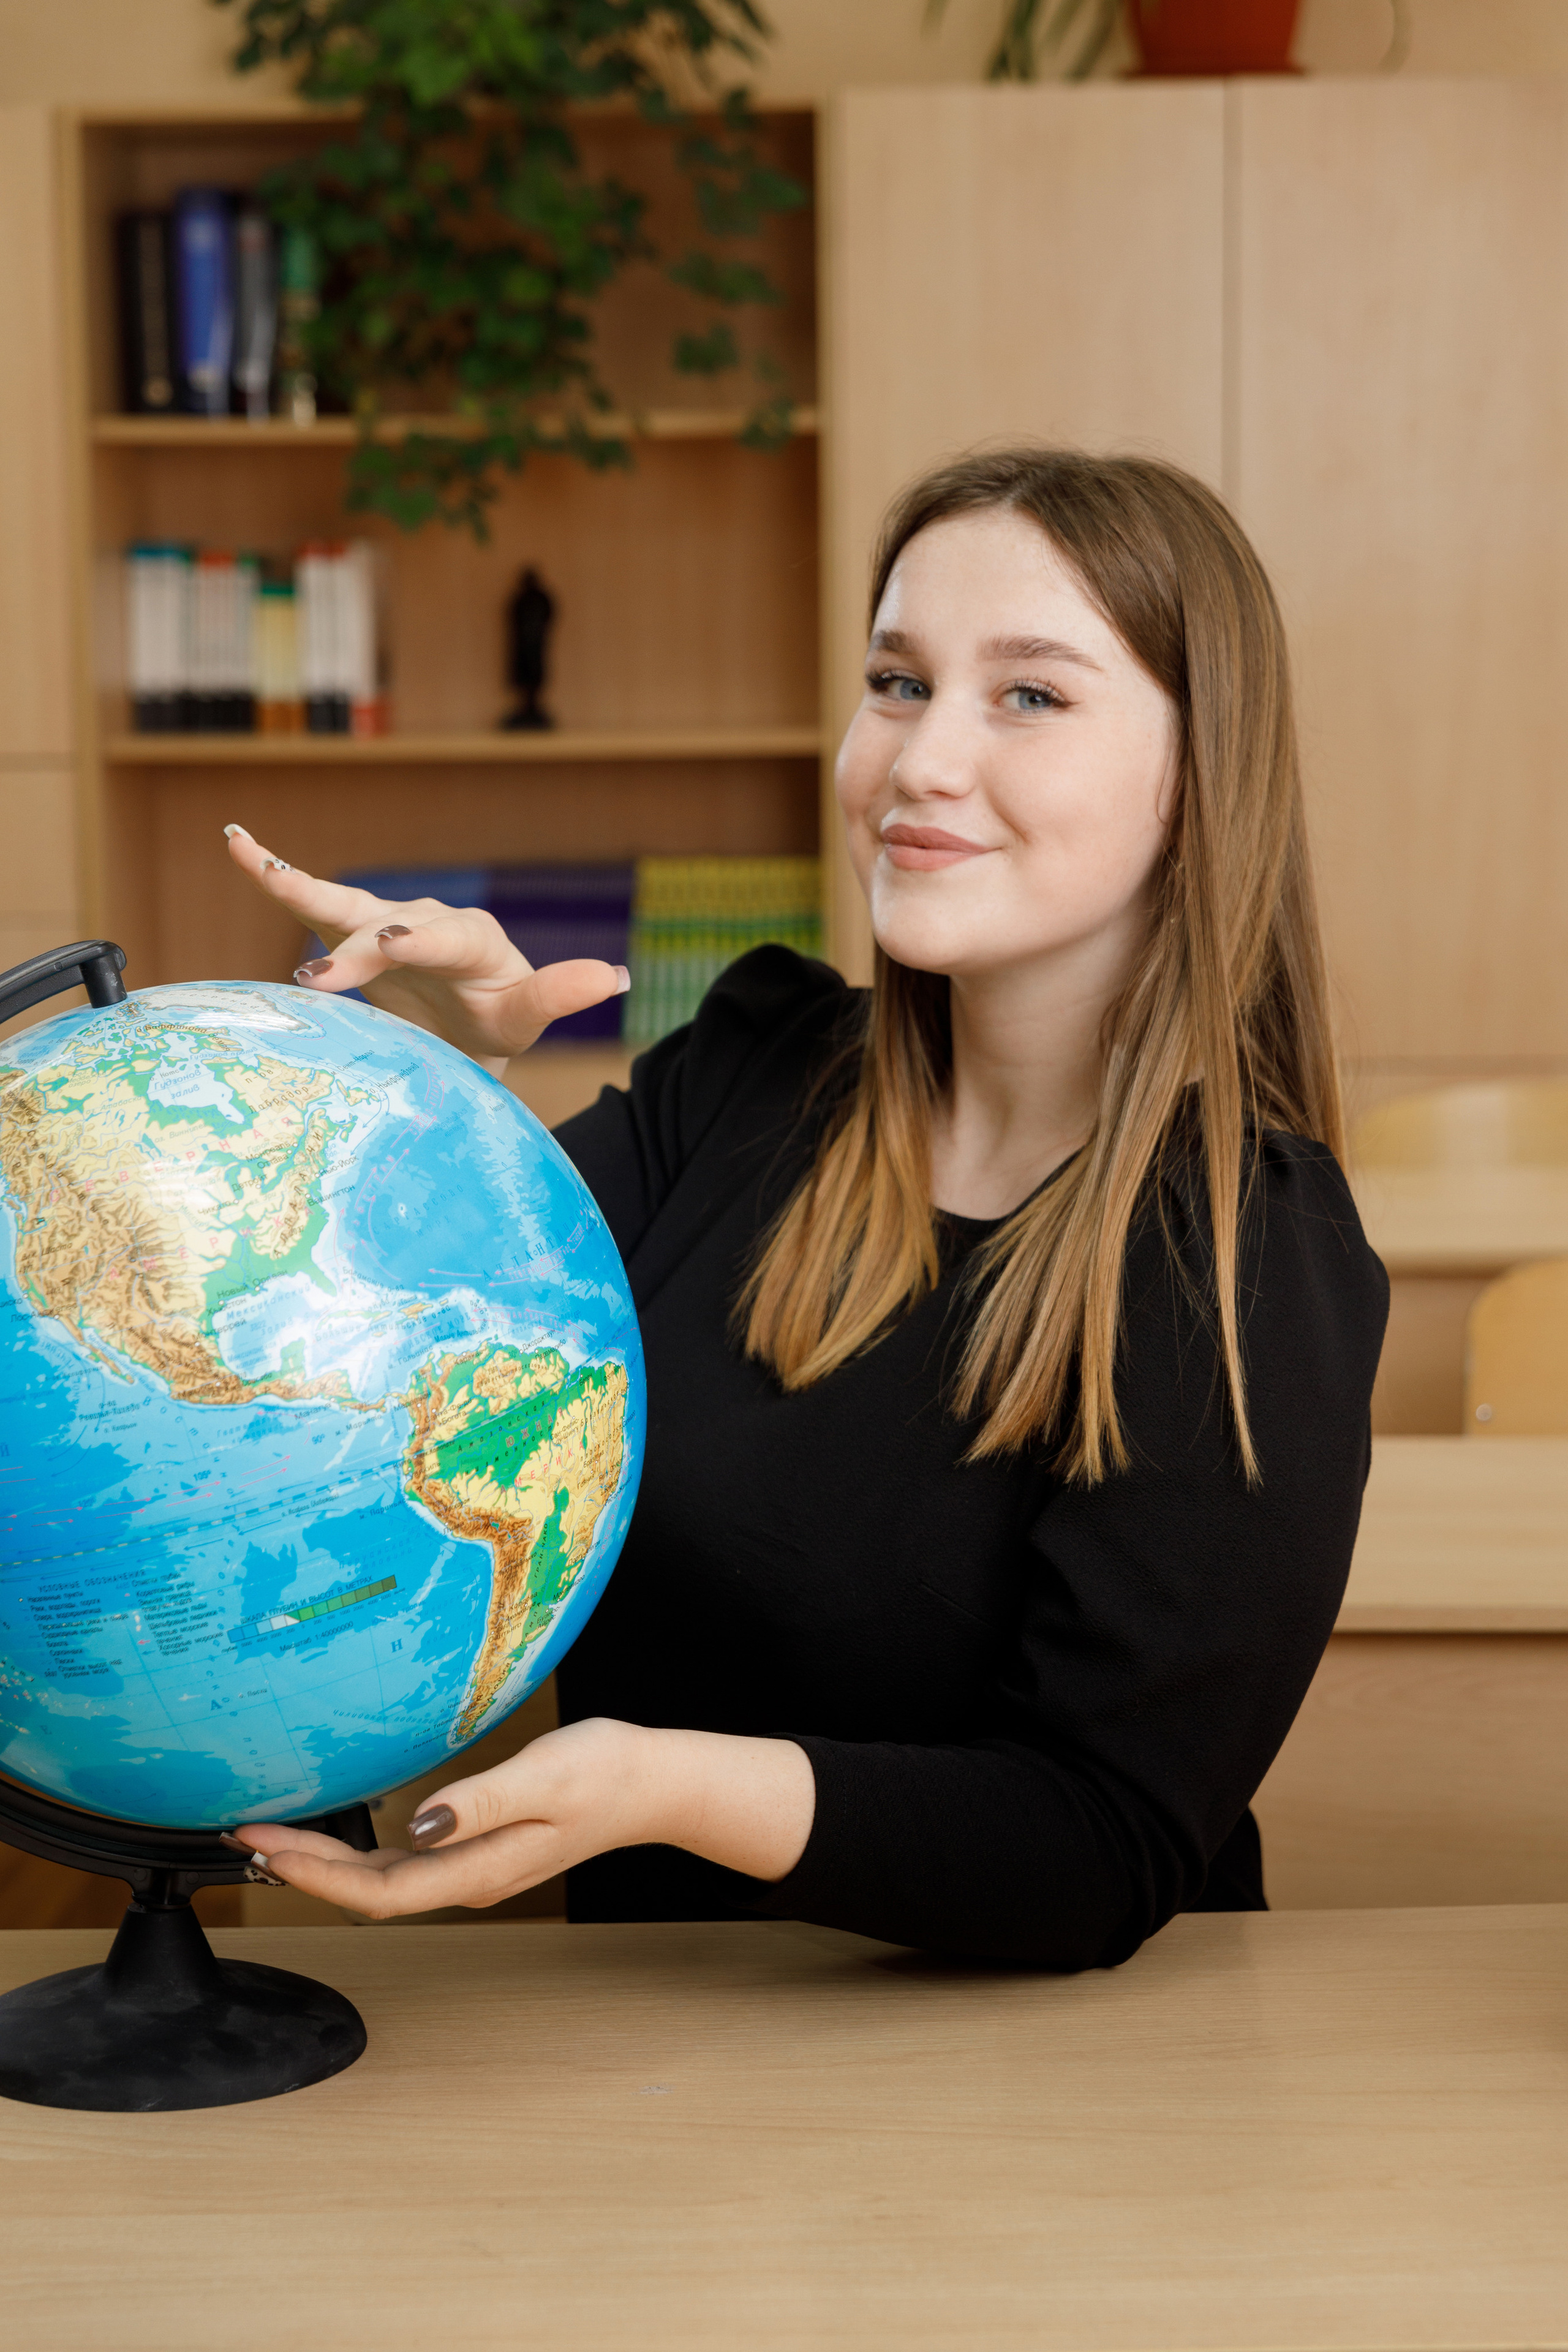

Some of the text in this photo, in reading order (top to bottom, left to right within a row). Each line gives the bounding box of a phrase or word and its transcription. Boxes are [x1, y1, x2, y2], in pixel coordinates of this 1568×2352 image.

[145, 1025, 230, 1052] Баффинова Земля
[230, 1046, 258, 1057] пролив
[337, 1050, 375, 1071] Сент-Чарльз
[154, 1070, 202, 1090] Гудзонов
[160, 1069, 179, 1078] Котс
[379, 1063, 420, 1088] Ньюфаундленд
[171, 1084, 200, 1099] залив
[249, 1086, 309, 1114] Лабрадор
[101, 1096, 142, 1110] Атабаска
[246, 1142, 290, 1163] Монреаль
[257, 1153, 289, 1169] Оттава
[319, 1155, 358, 1177] Нью-Йорк
[232, 1173, 268, 1192] Детройт
[307, 1185, 356, 1207] Вашингтон
[198, 1201, 232, 1215] Чикаго
[373, 1183, 464, 1236] САРГАССОВО
[416, 1215, 451, 1238] МОРЕ
[217, 1270, 288, 1298] Новый Орлеан
[522, 1329, 556, 1351] Джорджтаун
[535, 1339, 567, 1361] Парамарибо
[295, 1402, 332, 1420] Манагуа
[346, 1414, 382, 1431] Марьято
[457, 1400, 545, 1453] Амазонская
[506, 1407, 564, 1448] ЮЖНАЯ
[501, 1441, 584, 1494] АМЕРИКА
[552, 1574, 586, 1601] Монтевидео
[241, 1611, 266, 1624] ШКАЛА
[268, 1600, 298, 1617] ГЛУБИН
[309, 1590, 335, 1604] ВЫСОТ
[346, 1575, 373, 1591] МЕТРАХ
[279, 1636, 312, 1653] Масштаб
